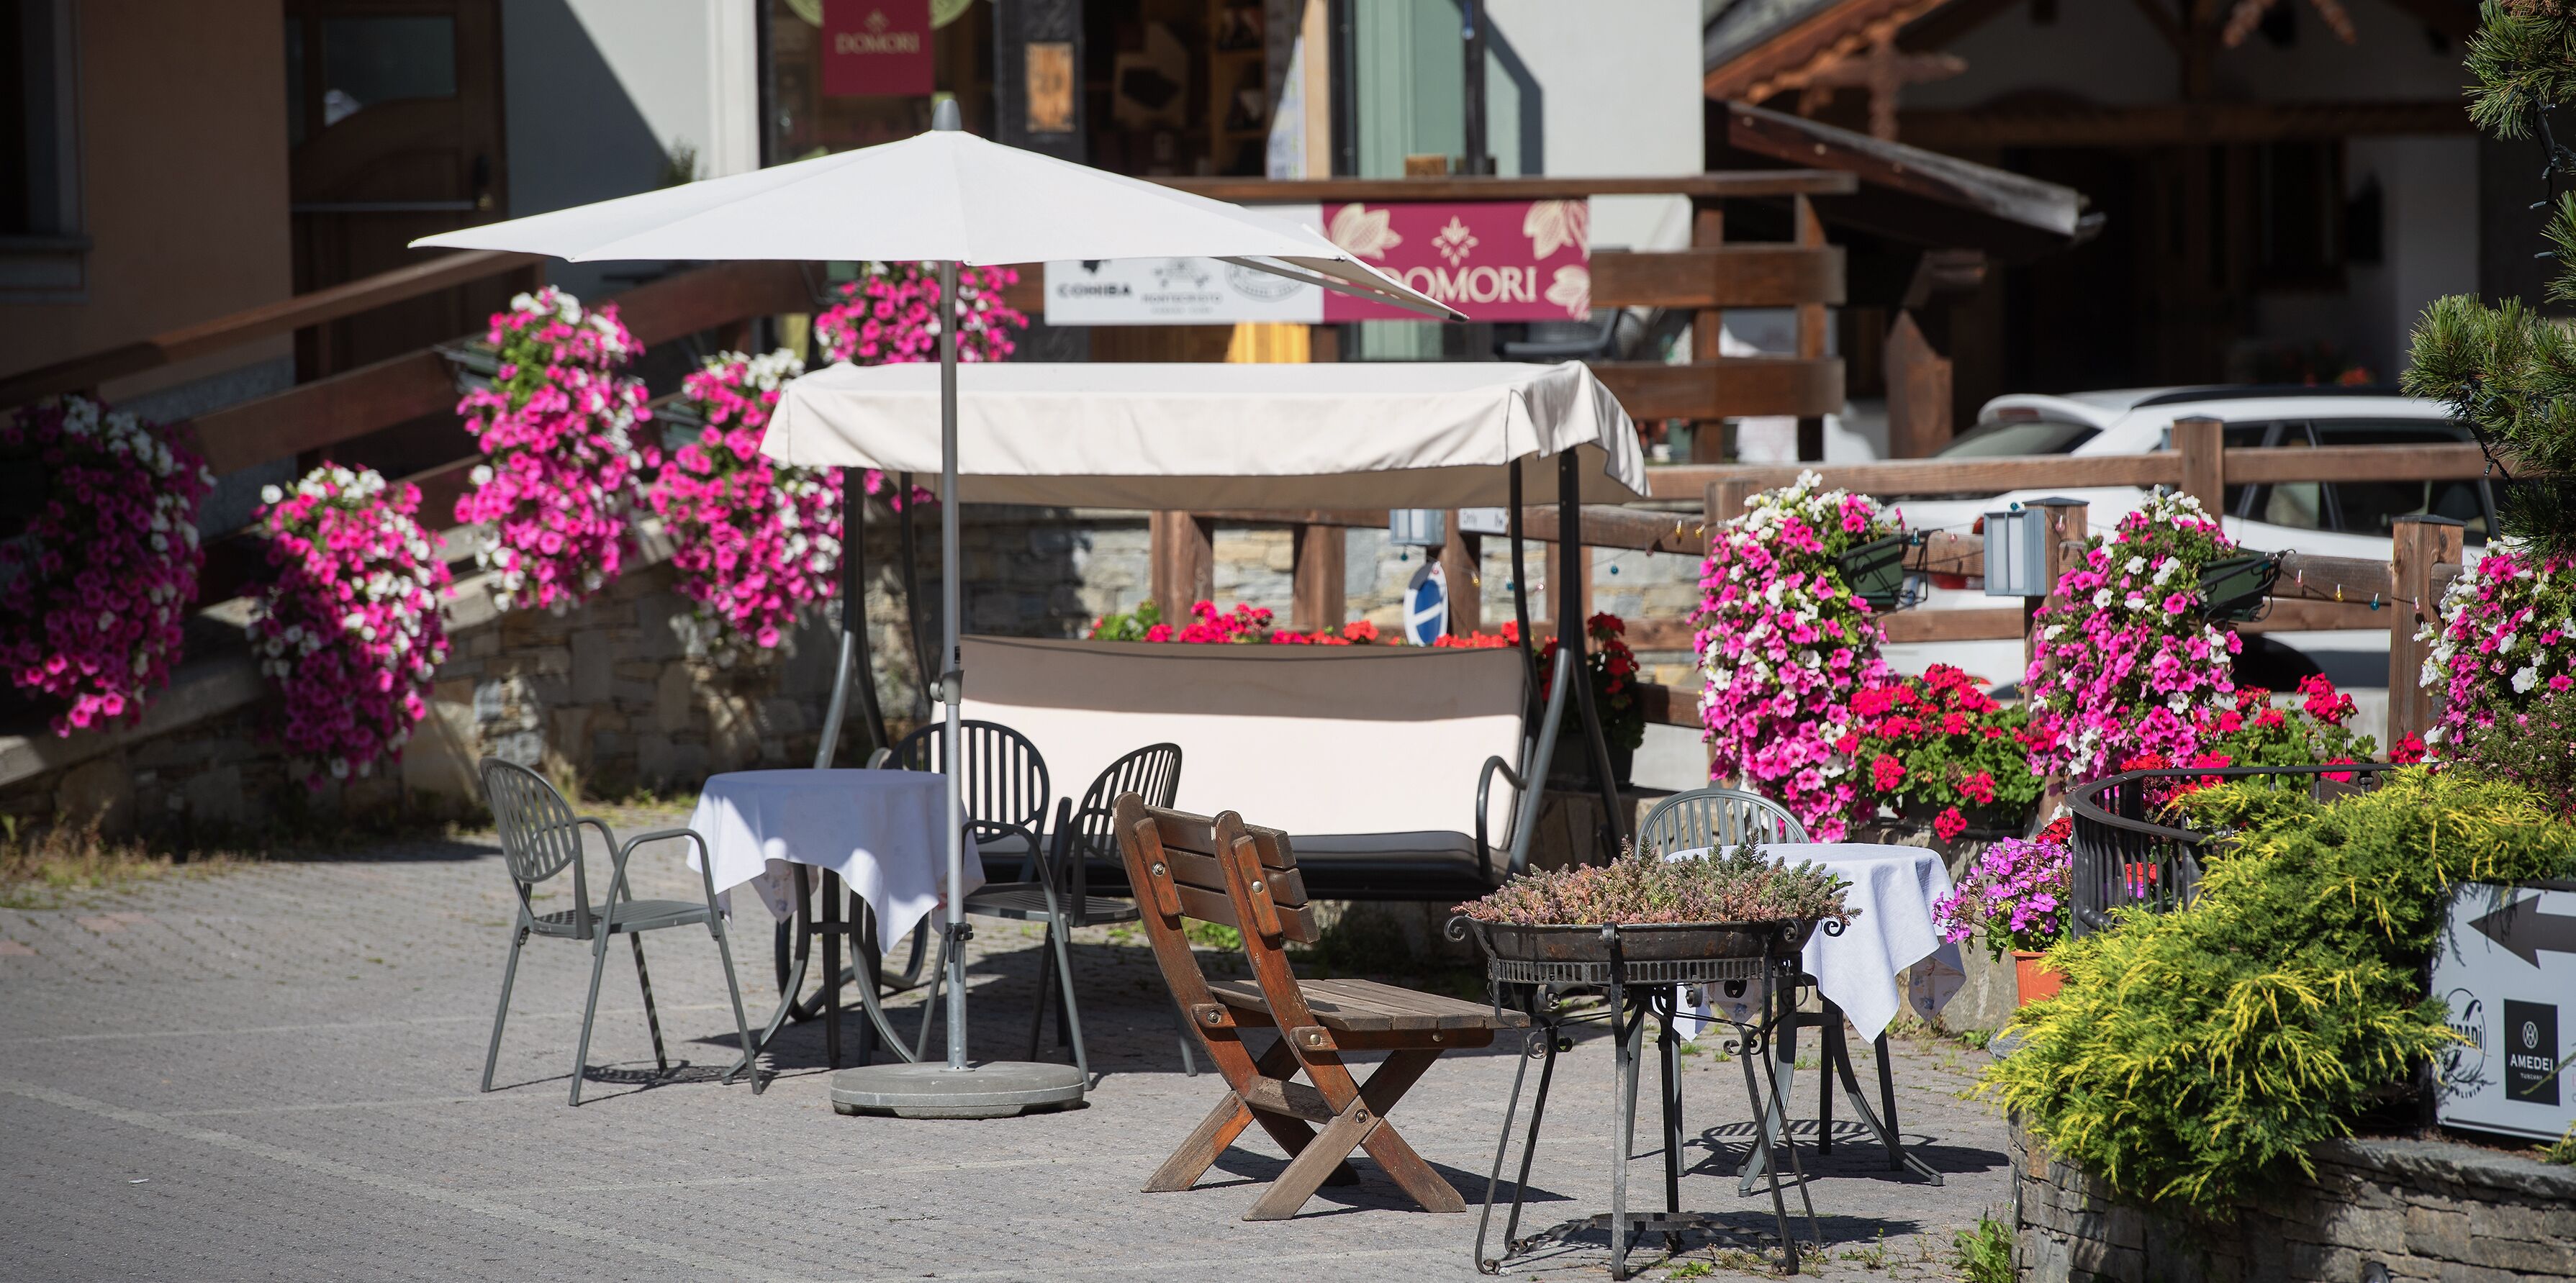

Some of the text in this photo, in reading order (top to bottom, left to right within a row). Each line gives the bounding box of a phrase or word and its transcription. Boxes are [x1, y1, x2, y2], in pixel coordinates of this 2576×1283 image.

[835, 32, 919, 54] DOMORI
[1057, 284, 1132, 299] COHIBA
[2510, 1053, 2553, 1072] AMEDEI
